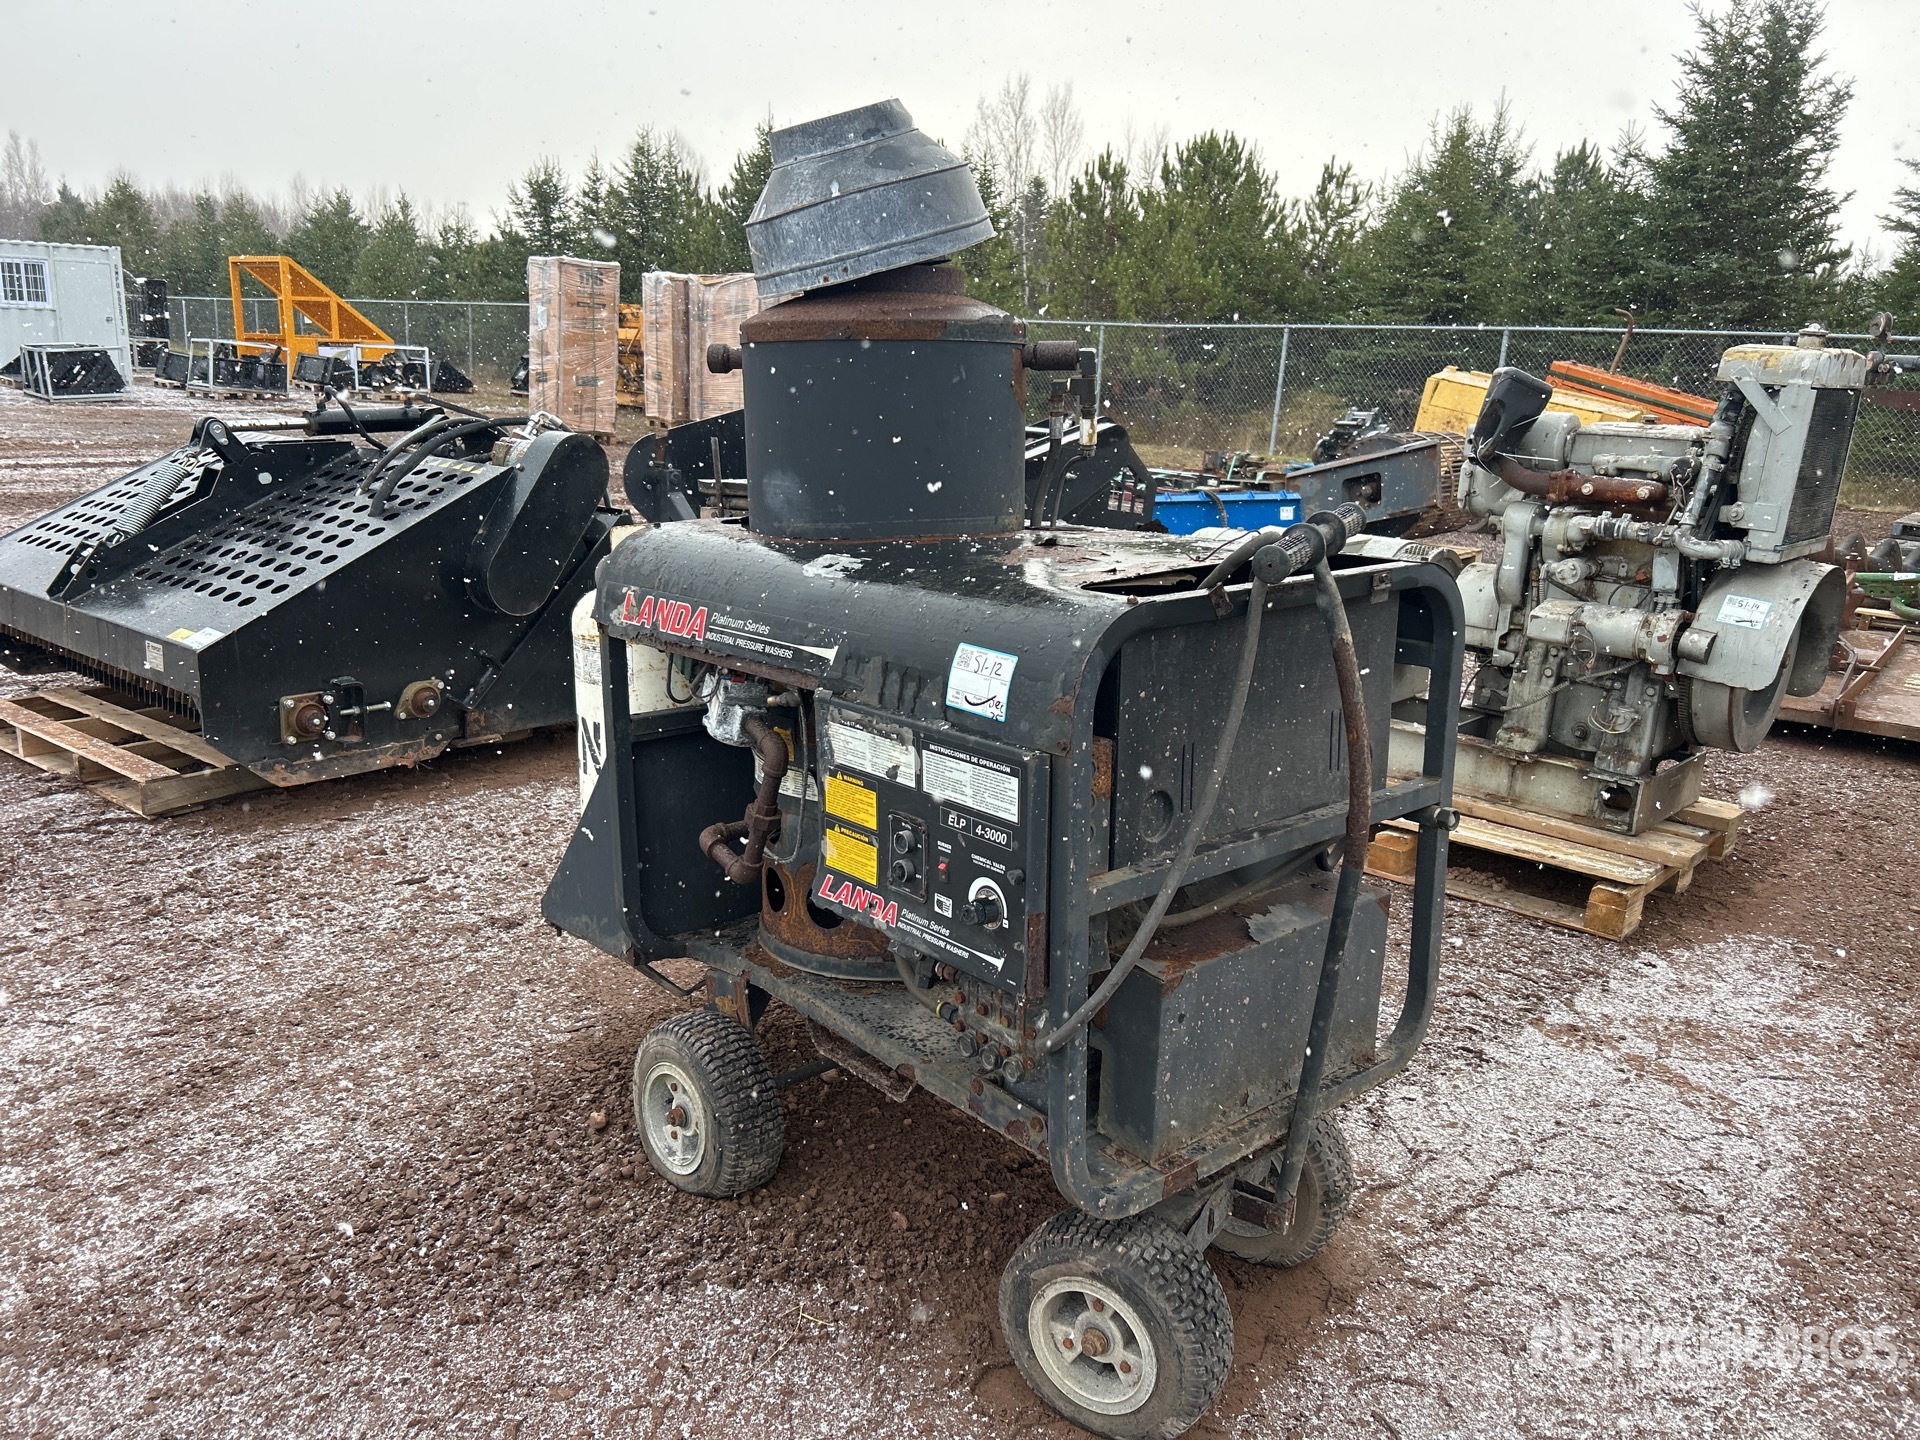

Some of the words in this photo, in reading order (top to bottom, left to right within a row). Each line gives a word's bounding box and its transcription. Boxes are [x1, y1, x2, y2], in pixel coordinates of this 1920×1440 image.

[621, 590, 708, 641] LANDA
[710, 612, 744, 629] Platinum
[745, 619, 770, 635] Series
[705, 631, 735, 646] INDUSTRIAL
[735, 638, 764, 652] PRESSURE
[764, 645, 794, 659] WASHERS
[929, 744, 970, 761] INSTRUCCIONES
[970, 756, 978, 764] DE
[979, 758, 1011, 773] OPERACIÓN
[948, 814, 966, 829] ELP
[975, 824, 1007, 845] 4-3000
[818, 873, 898, 928] LANDA
[901, 908, 929, 927] Platinum
[929, 920, 951, 937] Series
[897, 921, 922, 938] INDUSTRIAL
[922, 932, 946, 949] PRESSURE
[945, 943, 970, 959] WASHERS
